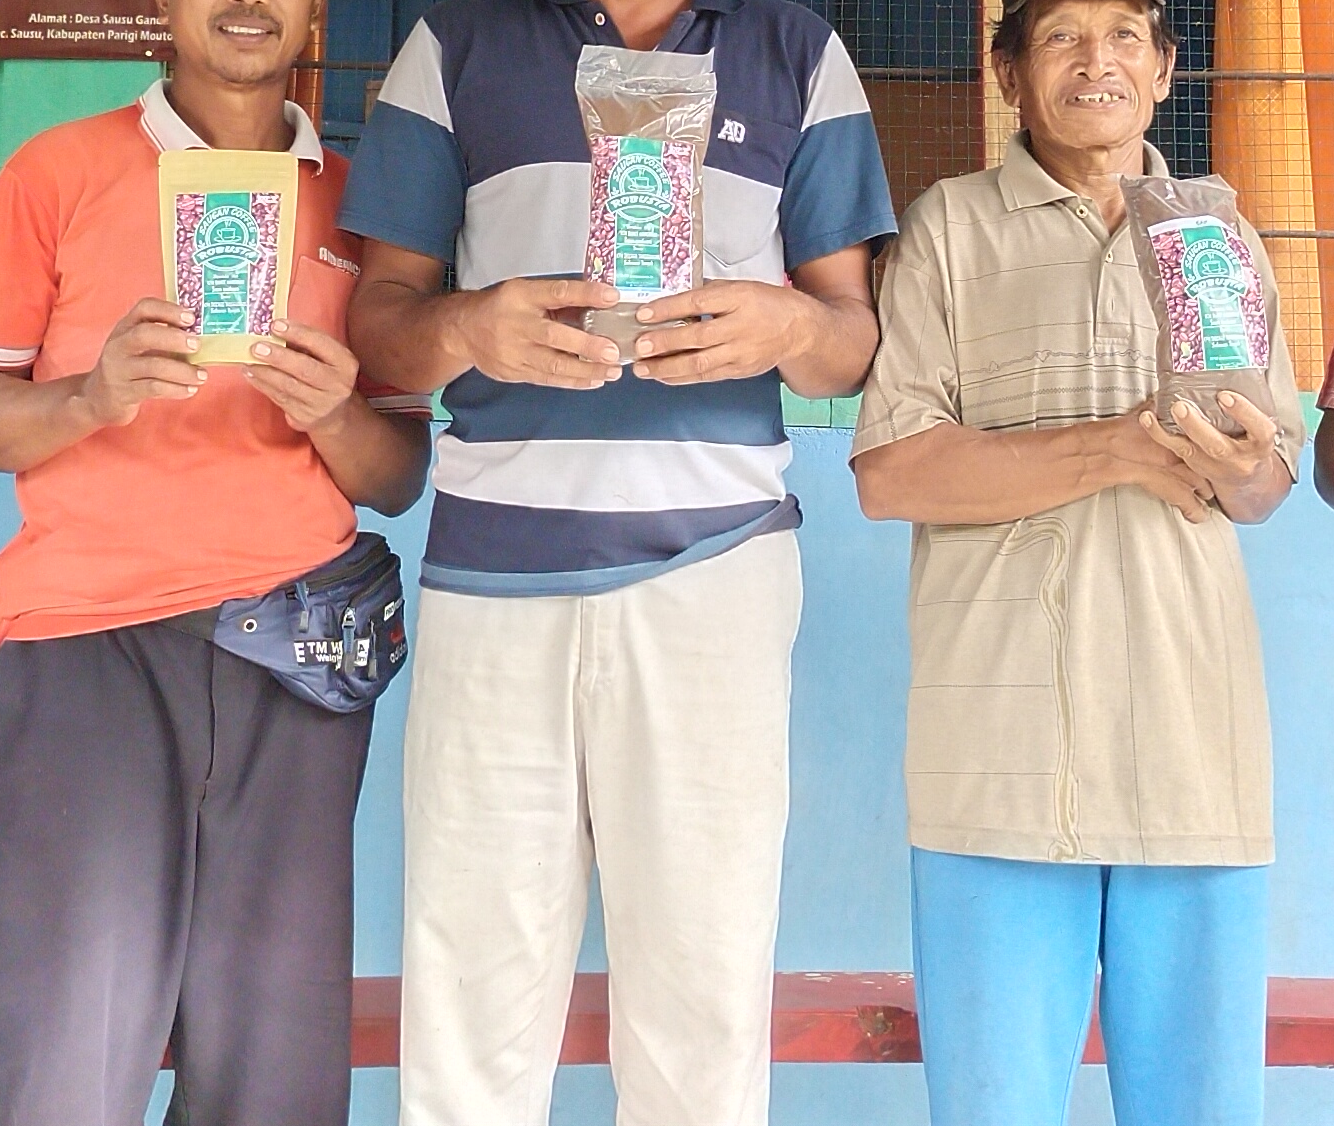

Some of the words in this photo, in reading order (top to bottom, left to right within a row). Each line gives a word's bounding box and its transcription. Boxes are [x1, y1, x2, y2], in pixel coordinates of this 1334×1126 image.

[28, 13, 67, 24] Alamat
[75, 13, 100, 24] Desa
[103, 14, 133, 25] Sausu
[10, 28, 45, 41] Sausu,
[47, 29, 105, 42] Kabupaten
[107, 30, 138, 43] Parigi
[610, 195, 669, 211] ROBUSTA
[199, 208, 229, 235] SAUGAN
[231, 208, 259, 233] COFFEE
[198, 244, 258, 261] ROBUSTA
